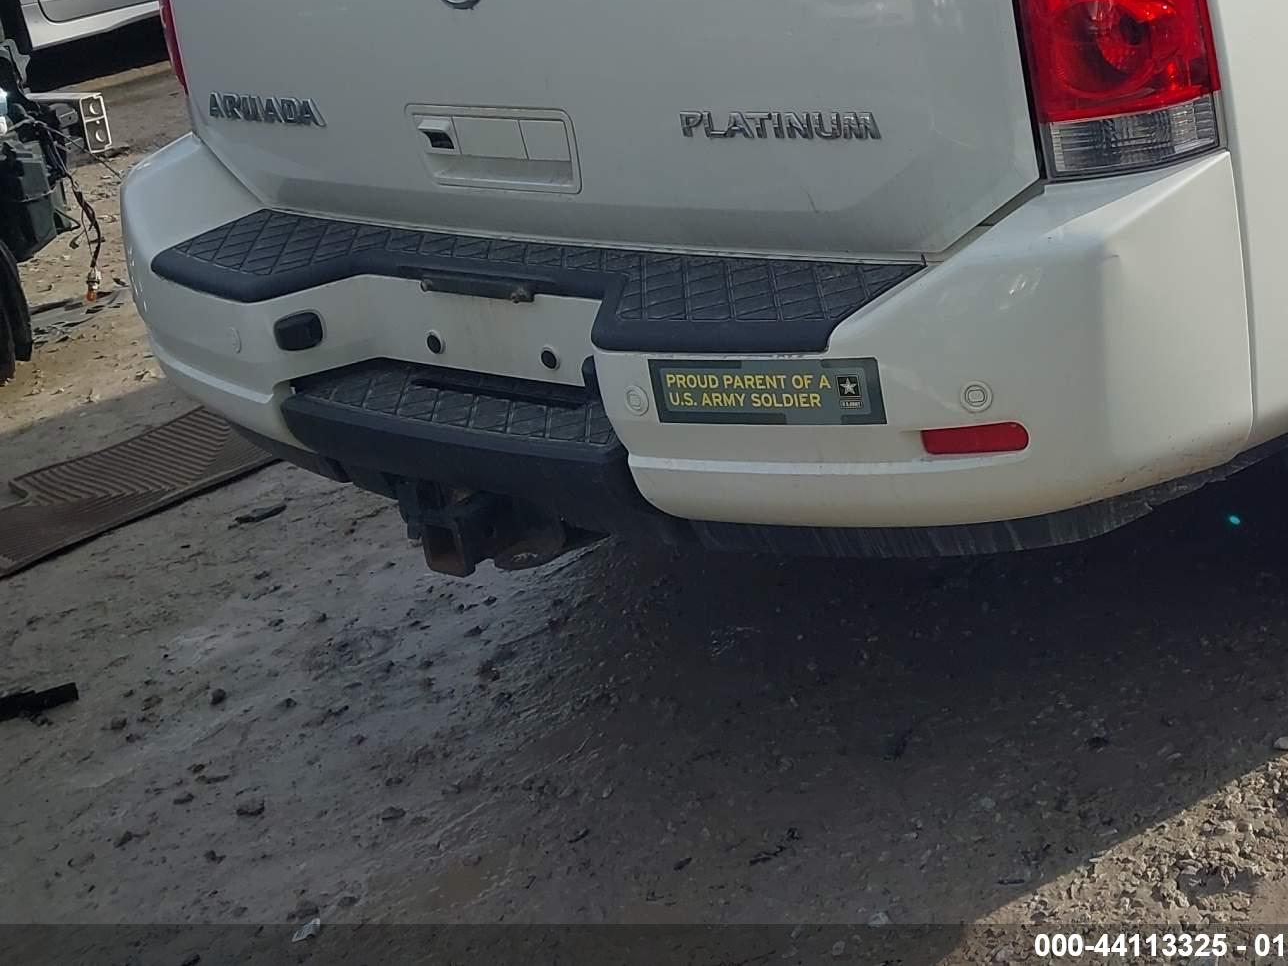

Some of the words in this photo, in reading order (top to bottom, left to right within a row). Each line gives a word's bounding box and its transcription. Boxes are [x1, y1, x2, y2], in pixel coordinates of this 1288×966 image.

[208, 91, 327, 128] ARMADA
[680, 111, 882, 140] PLATINUM
[666, 374, 719, 389] PROUD
[723, 374, 787, 390] PARENT
[791, 375, 814, 390] OF
[818, 374, 831, 388] A
[669, 392, 697, 406] U.S.
[701, 392, 746, 408] ARMY
[751, 392, 821, 408] SOLDIER
